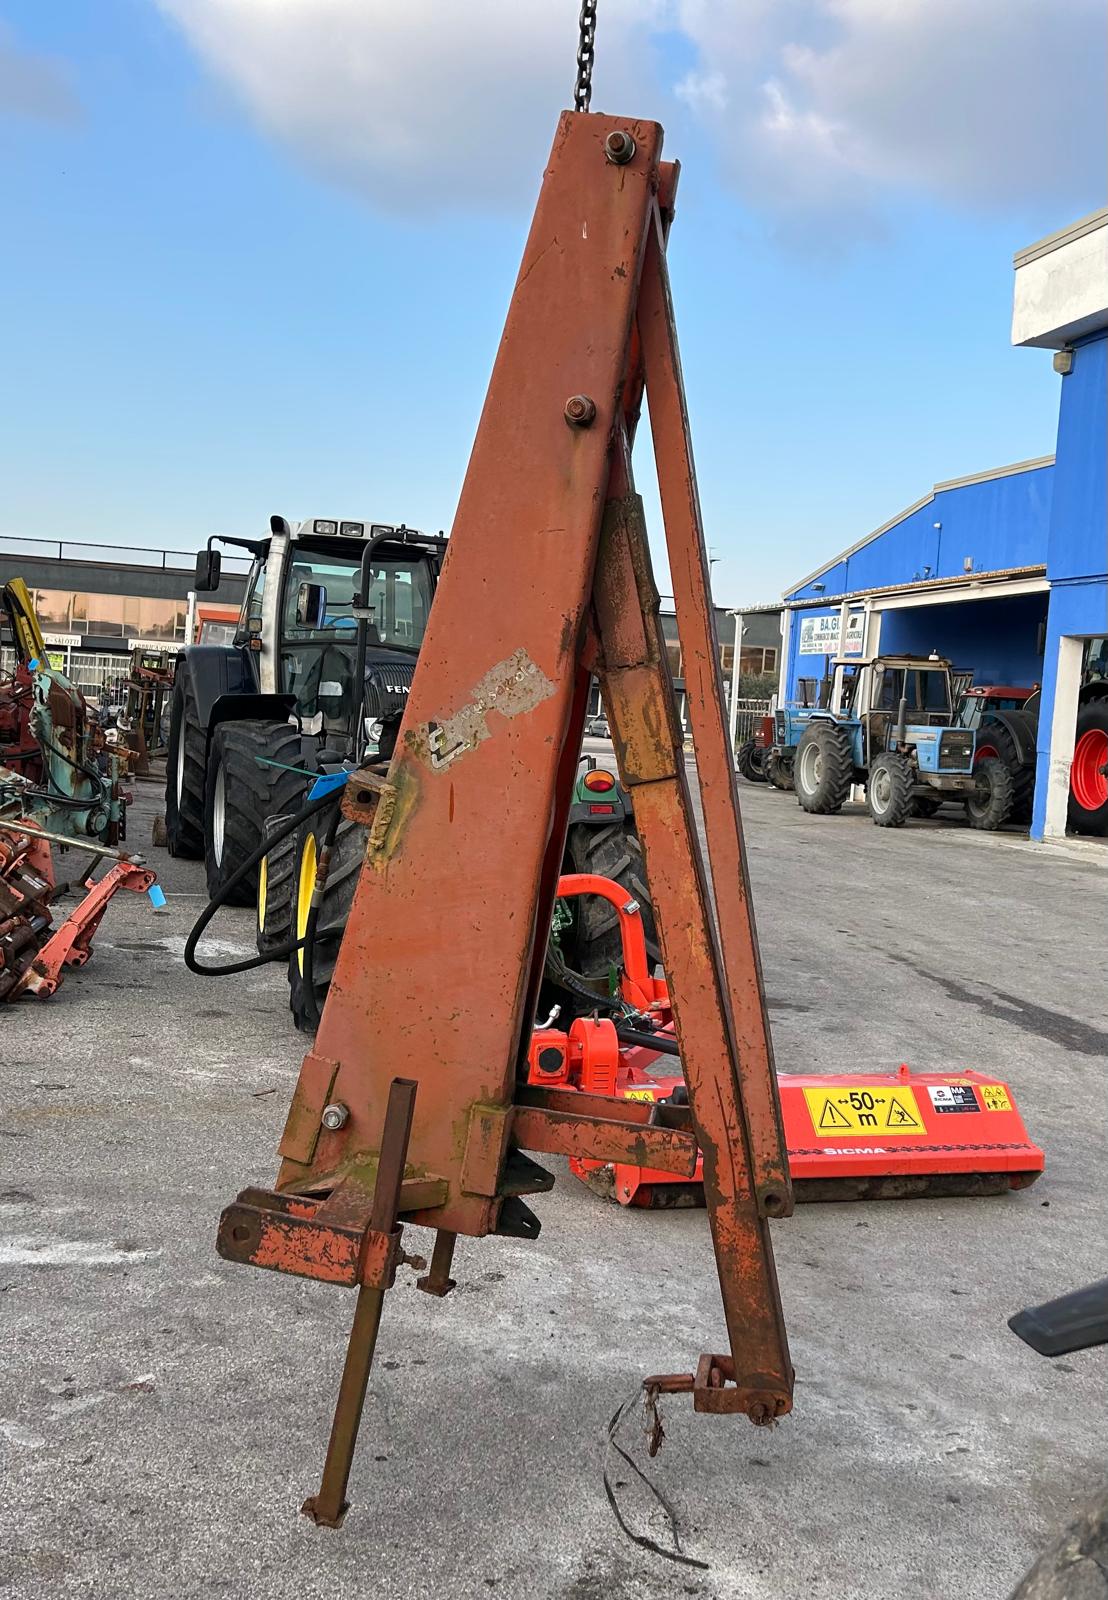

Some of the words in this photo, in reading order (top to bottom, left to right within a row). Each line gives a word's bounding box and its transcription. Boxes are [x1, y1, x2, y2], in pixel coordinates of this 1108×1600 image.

[849, 1092, 875, 1111] 50
[858, 1113, 878, 1126] m
[823, 1147, 887, 1155] SICMA
